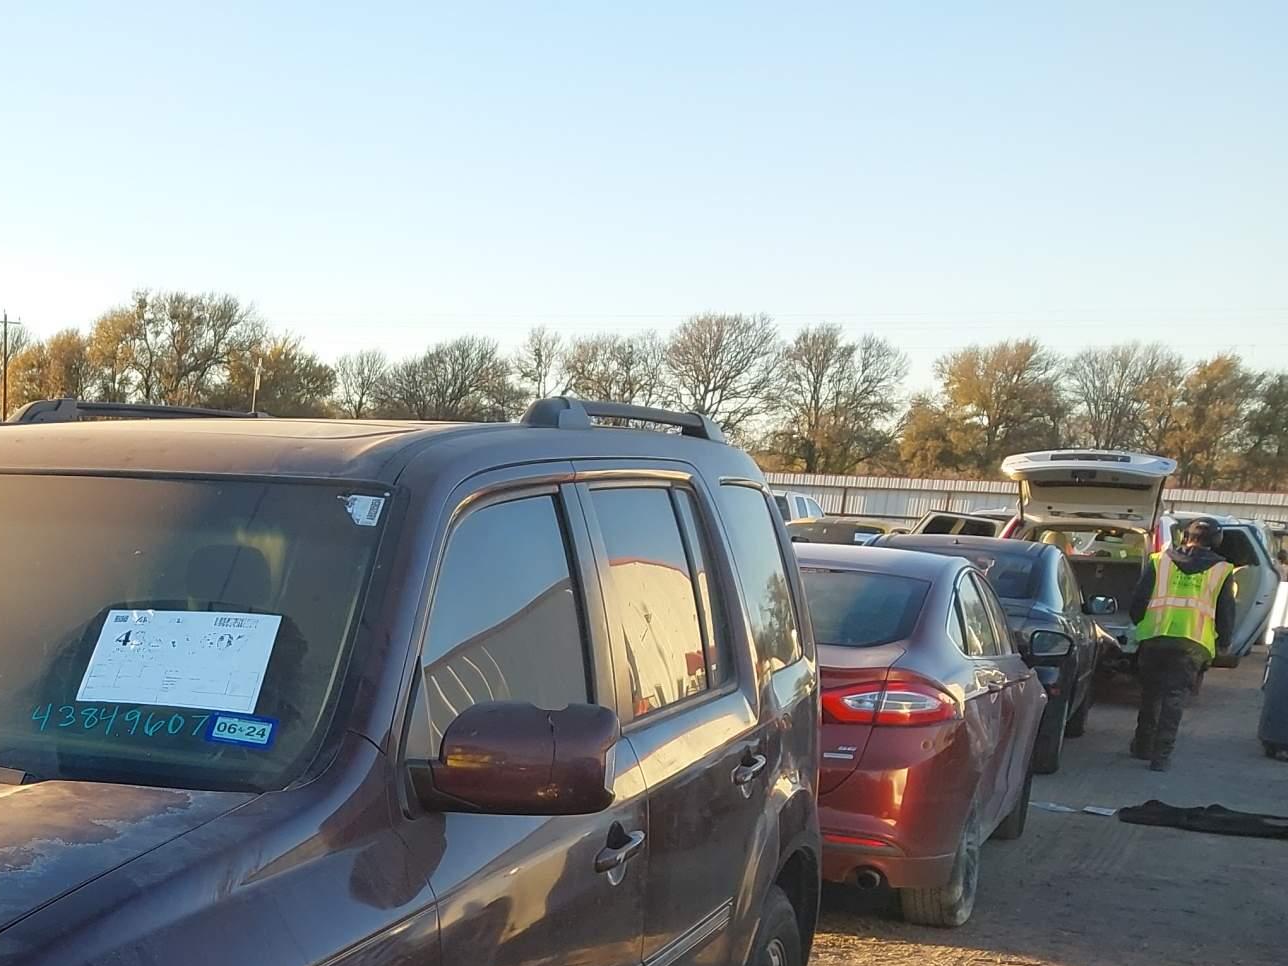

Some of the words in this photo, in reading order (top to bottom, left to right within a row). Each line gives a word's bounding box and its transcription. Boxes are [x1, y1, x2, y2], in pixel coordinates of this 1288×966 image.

[31, 703, 210, 737] 43849607
[216, 721, 238, 735] 06
[245, 725, 267, 739] 24
